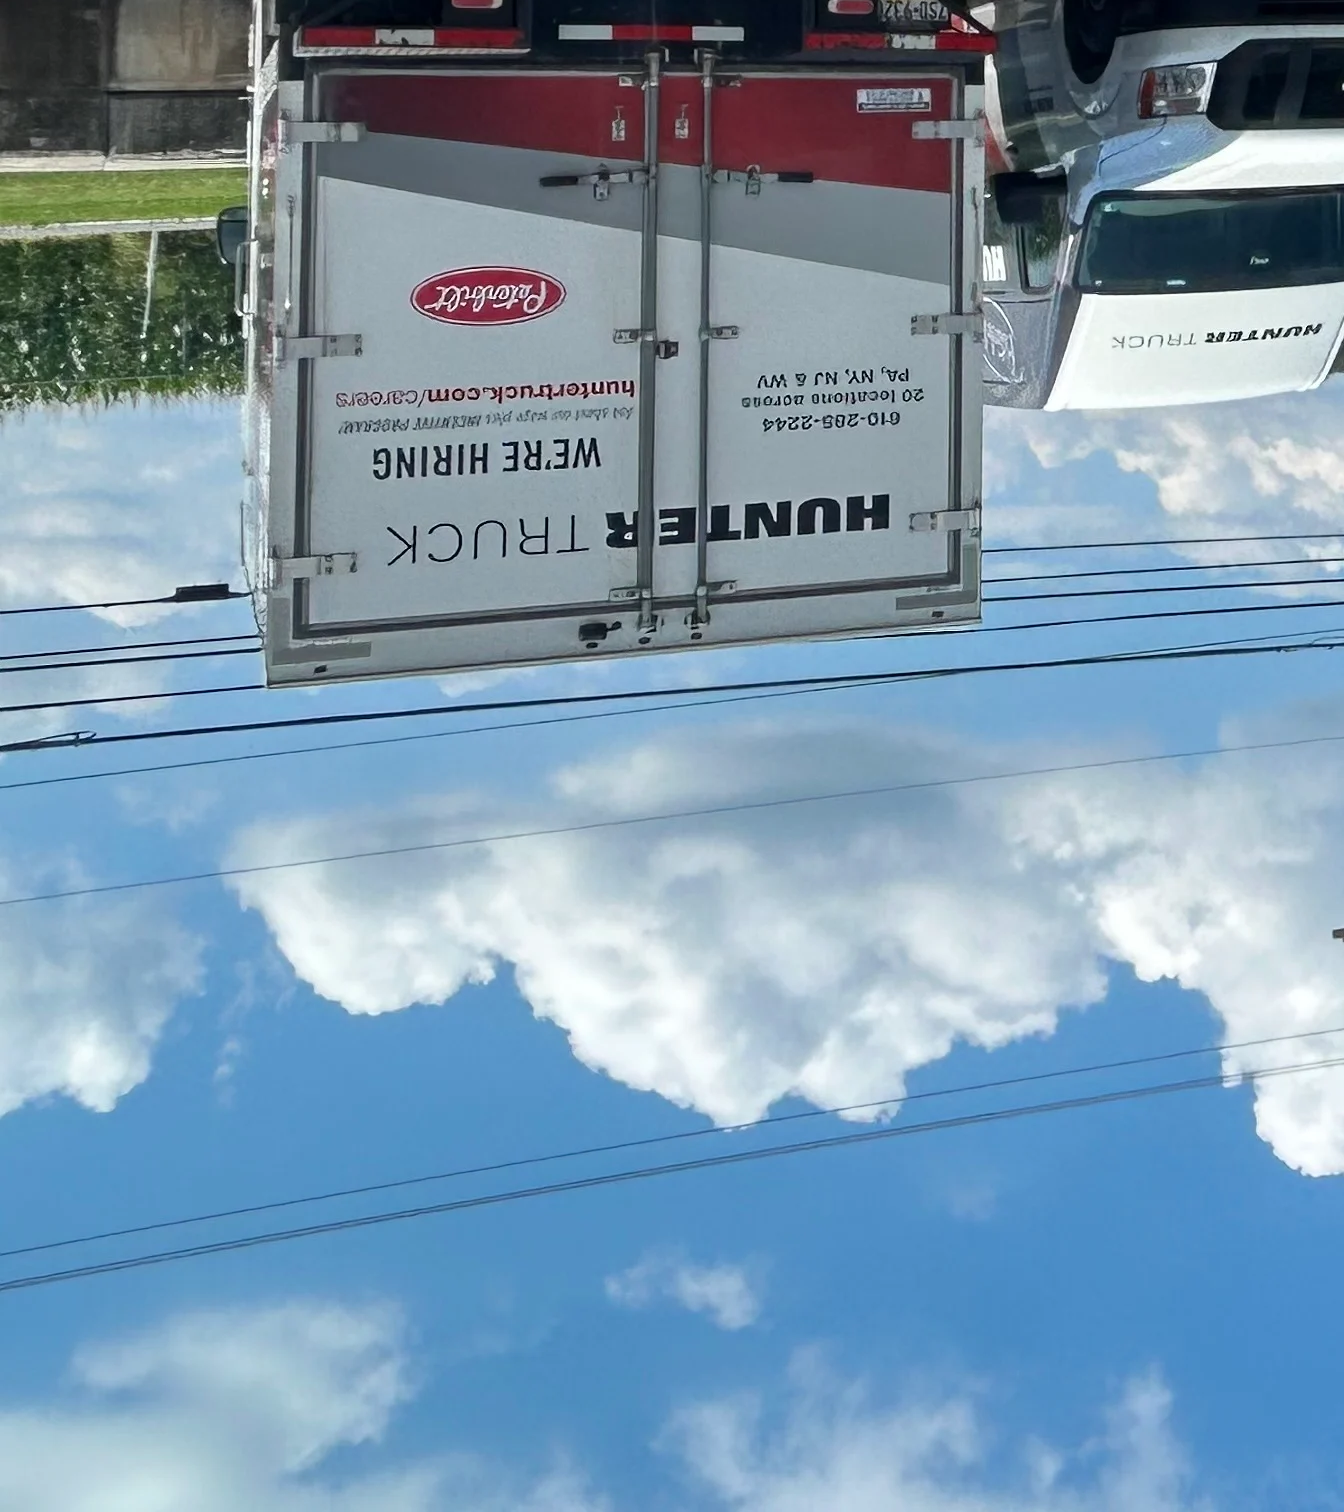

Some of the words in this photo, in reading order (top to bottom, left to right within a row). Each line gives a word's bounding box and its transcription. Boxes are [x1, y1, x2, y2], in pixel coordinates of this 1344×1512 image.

[423, 280, 547, 314] Peterbilt
[1110, 332, 1197, 349] TRUCK
[1204, 323, 1323, 344] HUNTER
[756, 373, 788, 389] WV
[794, 373, 807, 387] &
[813, 371, 838, 387] NJ
[844, 368, 874, 385] NY,
[880, 366, 910, 383] PA,
[335, 380, 635, 409] huntertruck.com/careers
[740, 394, 804, 408] across
[811, 389, 895, 406] locations
[901, 388, 924, 403] 20
[371, 442, 490, 481] HIRING
[501, 437, 602, 473] WE'RE
[605, 494, 890, 549] HUNTER
[386, 514, 589, 566] TRUCK
